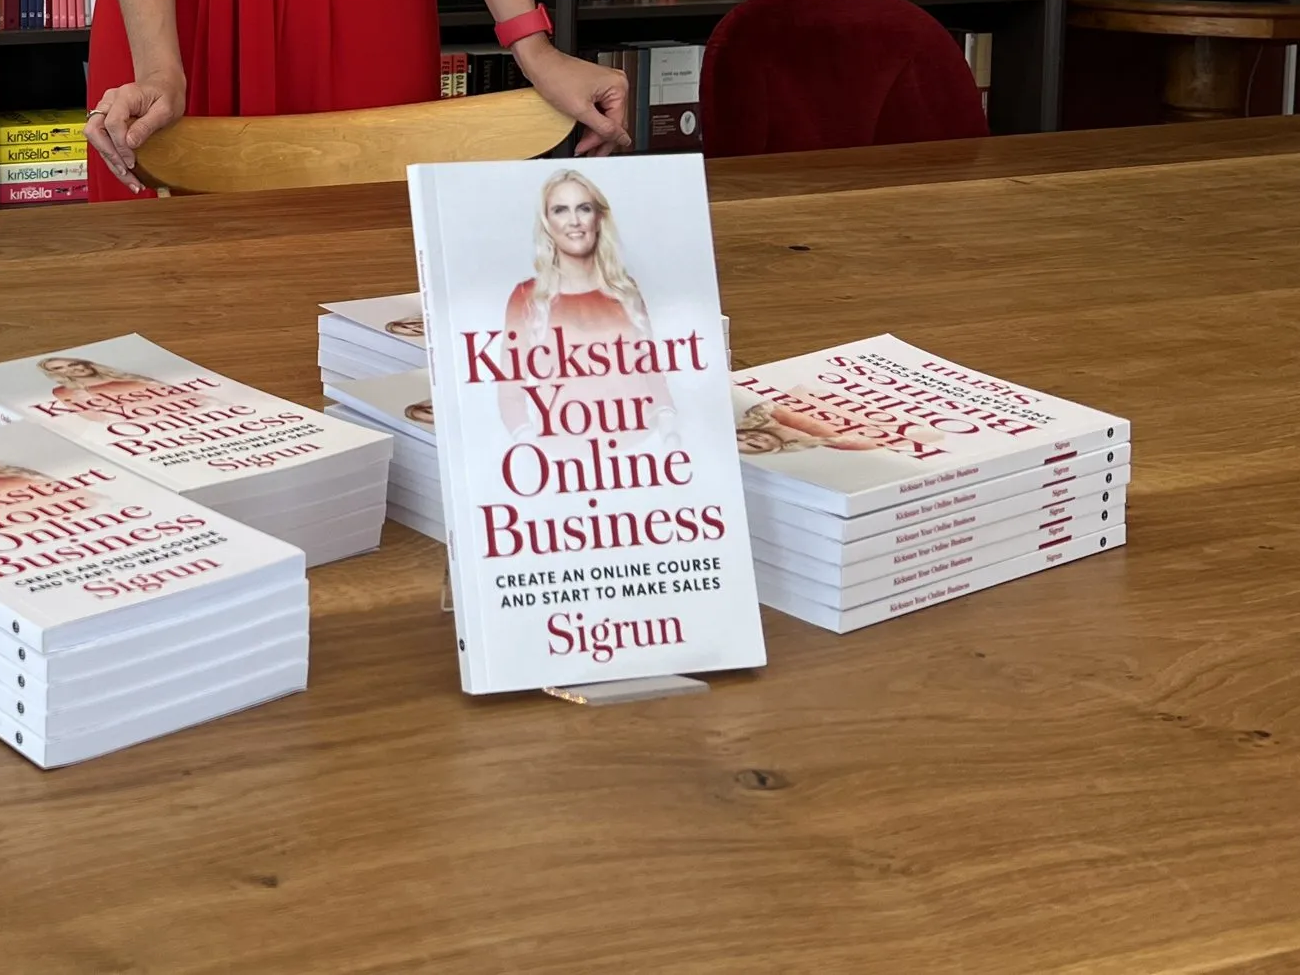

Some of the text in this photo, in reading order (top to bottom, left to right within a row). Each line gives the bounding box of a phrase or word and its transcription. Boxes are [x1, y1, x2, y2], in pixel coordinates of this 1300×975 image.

[6, 128, 49, 142] kinsella
[8, 146, 50, 160] kinsella
[460, 326, 709, 385] Kickstart
[31, 374, 221, 418] Kickstart
[96, 394, 203, 424] Your
[818, 373, 980, 437] Online
[827, 356, 1042, 438] Business
[921, 360, 1042, 407] Sigrun
[104, 401, 257, 439] Online
[107, 407, 305, 458] Business
[521, 384, 655, 437] Your
[732, 374, 947, 462] Kickstart
[809, 391, 923, 444] Your
[207, 441, 322, 473] Sigrun
[501, 437, 693, 497] Online
[477, 498, 727, 559] Business
[14, 529, 221, 589] CREATE AN ONLINE COURSE
[29, 535, 228, 593] AND START TO MAKE SALES
[81, 554, 224, 601] Sigrun
[495, 556, 722, 590] CREATE AN ONLINE COURSE
[501, 576, 721, 609] AND START TO MAKE SALES
[546, 612, 686, 664] Sigrun
